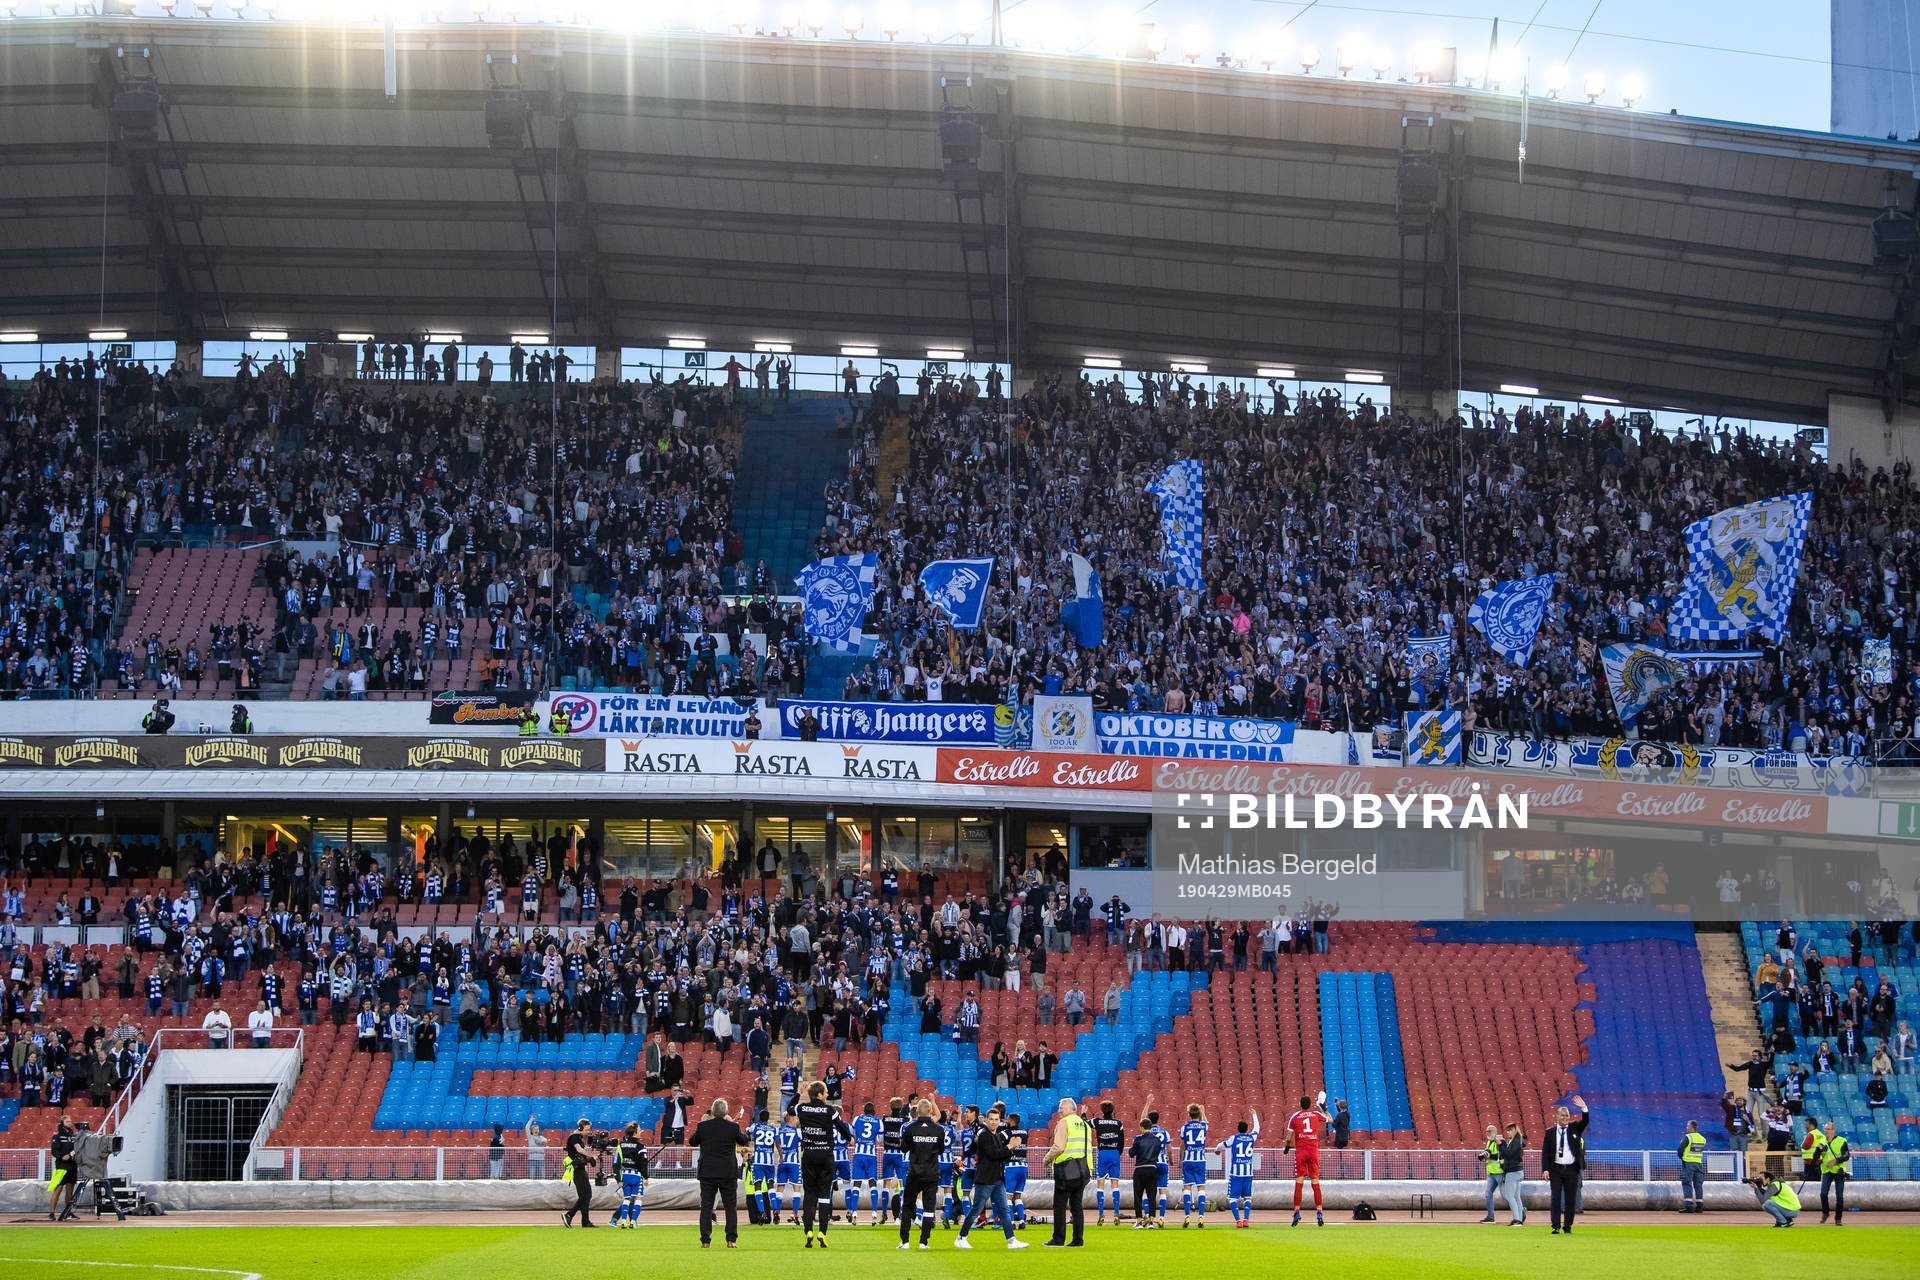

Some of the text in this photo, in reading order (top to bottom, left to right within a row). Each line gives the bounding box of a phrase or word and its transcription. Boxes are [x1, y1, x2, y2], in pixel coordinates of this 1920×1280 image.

[115, 345, 128, 357] P1
[688, 354, 703, 365] A1
[929, 364, 946, 375] A3
[561, 701, 589, 720] GP
[601, 695, 639, 711] FÖR
[645, 698, 671, 711] EN
[599, 712, 746, 738] LÄKTRKULTU
[875, 706, 987, 739] hangers
[1101, 715, 1226, 740] OKTOBER
[1066, 738, 1078, 746] ÅR
[55, 742, 138, 766] KOPPARBERG
[185, 742, 268, 767] KOPPARBERG
[279, 742, 361, 766] KOPPARBERG
[408, 744, 489, 768] KOPPARBERG
[501, 744, 582, 768] KOPPARBERG
[623, 753, 702, 773] RASTA
[1780, 760, 1797, 768] DOM
[735, 754, 812, 775] RASTA
[843, 758, 921, 780] RASTA
[953, 755, 1040, 782] Estrella
[1052, 759, 1139, 785] Estrella
[1155, 761, 1260, 793] Estrella
[1265, 767, 1373, 797] Estrella
[1616, 790, 1706, 817] Estrella
[1721, 799, 1812, 824] Estrella
[802, 1105, 828, 1113] SERNEKE
[861, 1122, 873, 1138] 3
[1302, 1117, 1313, 1133] 1
[755, 1130, 775, 1146] 28
[780, 1132, 796, 1148] 17
[912, 1135, 939, 1143] SERNEKE
[1185, 1129, 1206, 1145] 14
[1236, 1141, 1254, 1158] 16
